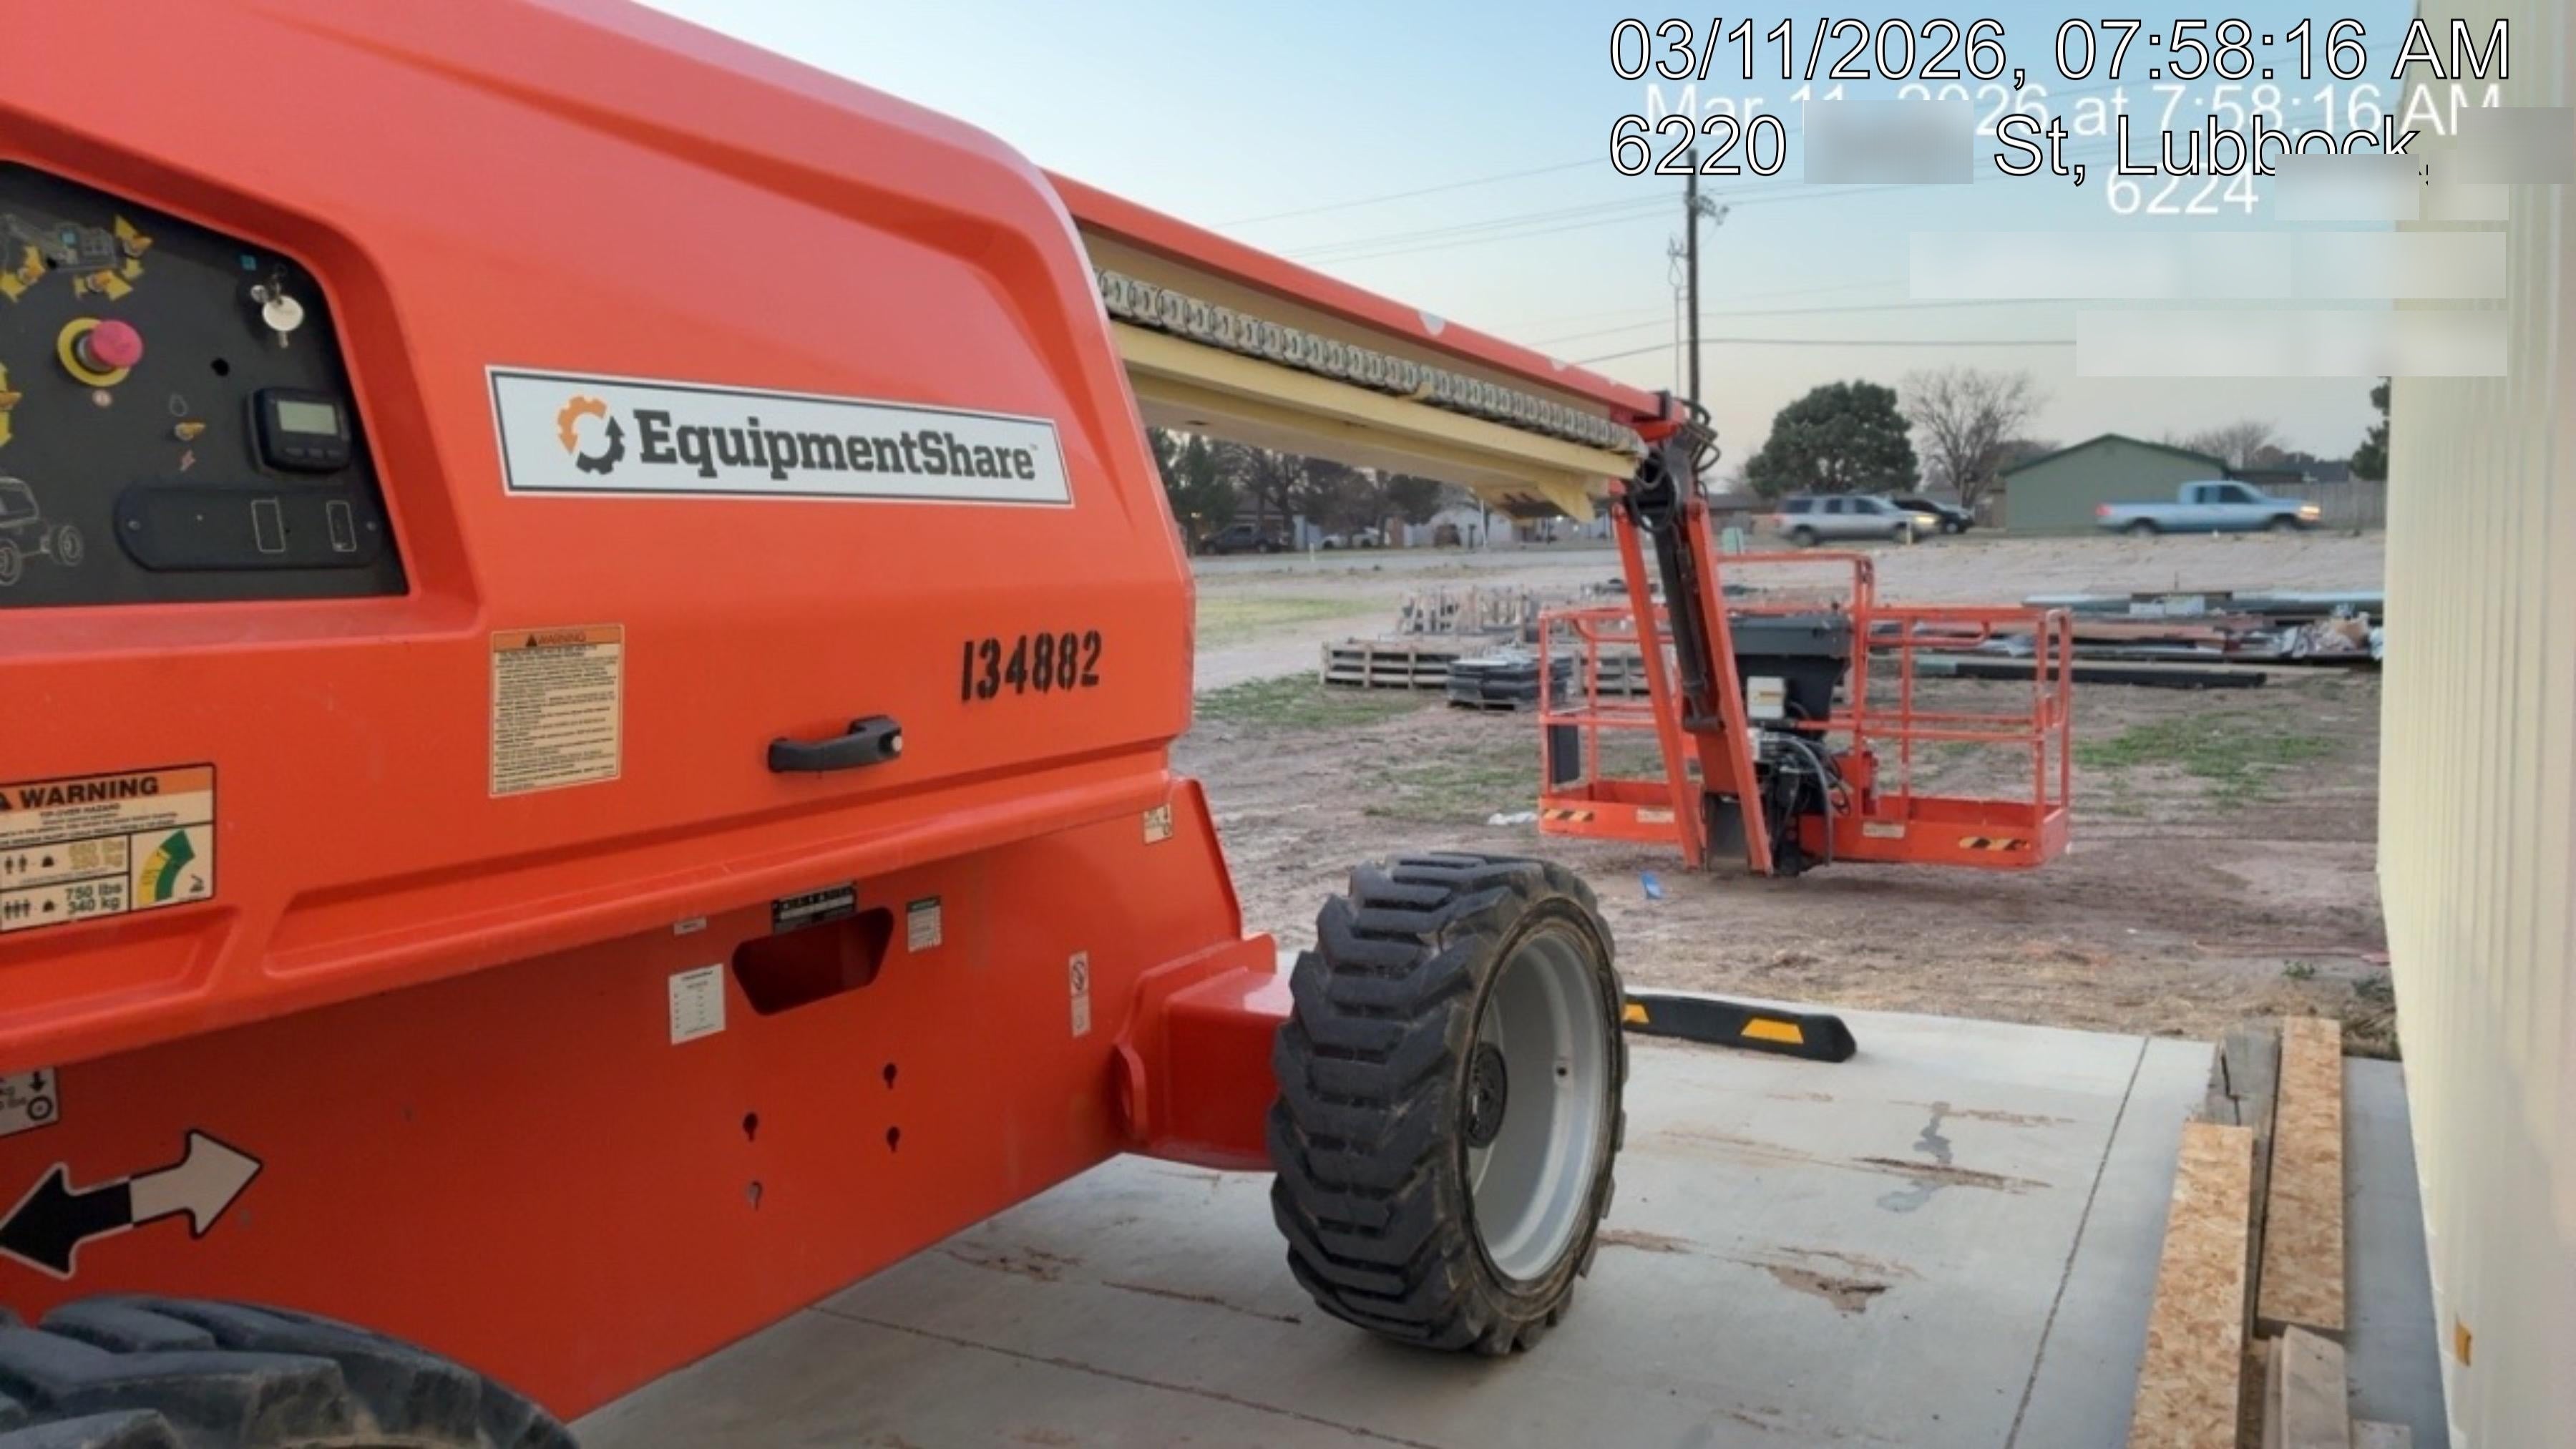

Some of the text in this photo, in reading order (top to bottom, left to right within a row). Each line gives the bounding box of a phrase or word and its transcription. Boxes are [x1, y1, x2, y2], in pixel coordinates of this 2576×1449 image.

[633, 409, 1035, 480] EquipmentShare
[962, 630, 1101, 701] 134882
[19, 776, 159, 809] WARNING
